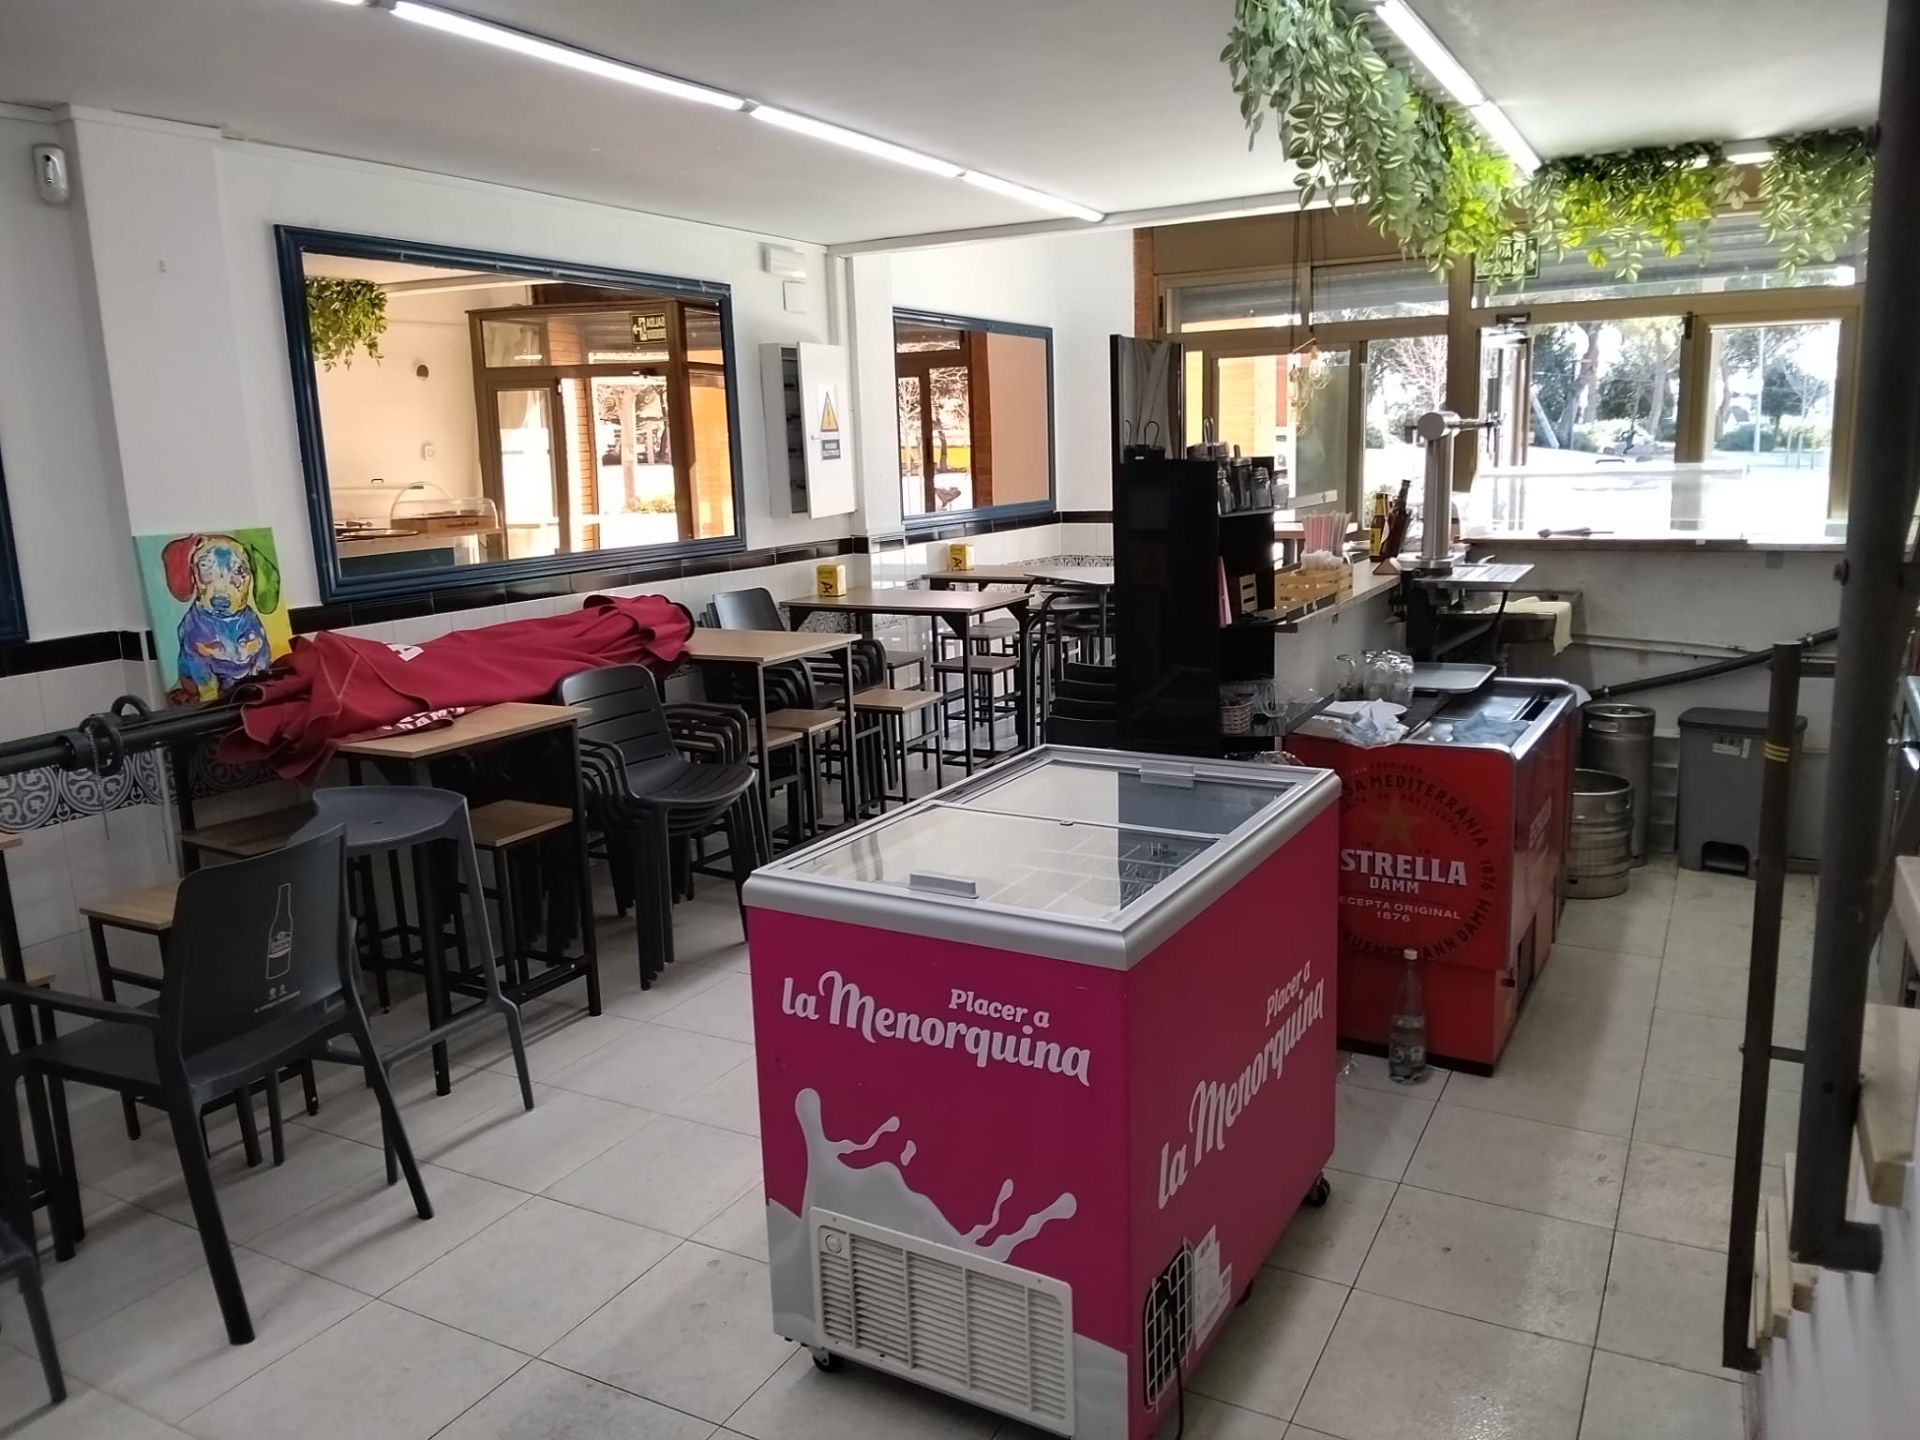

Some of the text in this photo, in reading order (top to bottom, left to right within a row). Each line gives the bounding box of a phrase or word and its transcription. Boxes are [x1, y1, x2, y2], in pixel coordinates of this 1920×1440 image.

[1339, 848, 1467, 886] STRELLA
[1369, 876, 1420, 894] DAMM
[1338, 895, 1391, 910] ECEPTA
[1394, 903, 1461, 920] ORIGINAL
[1376, 911, 1411, 923] 1876
[949, 989, 1050, 1028] Placer a
[1265, 960, 1311, 1028] Placer a
[781, 970, 1091, 1087] la Menorquina
[1158, 977, 1325, 1210] la Menorquina
